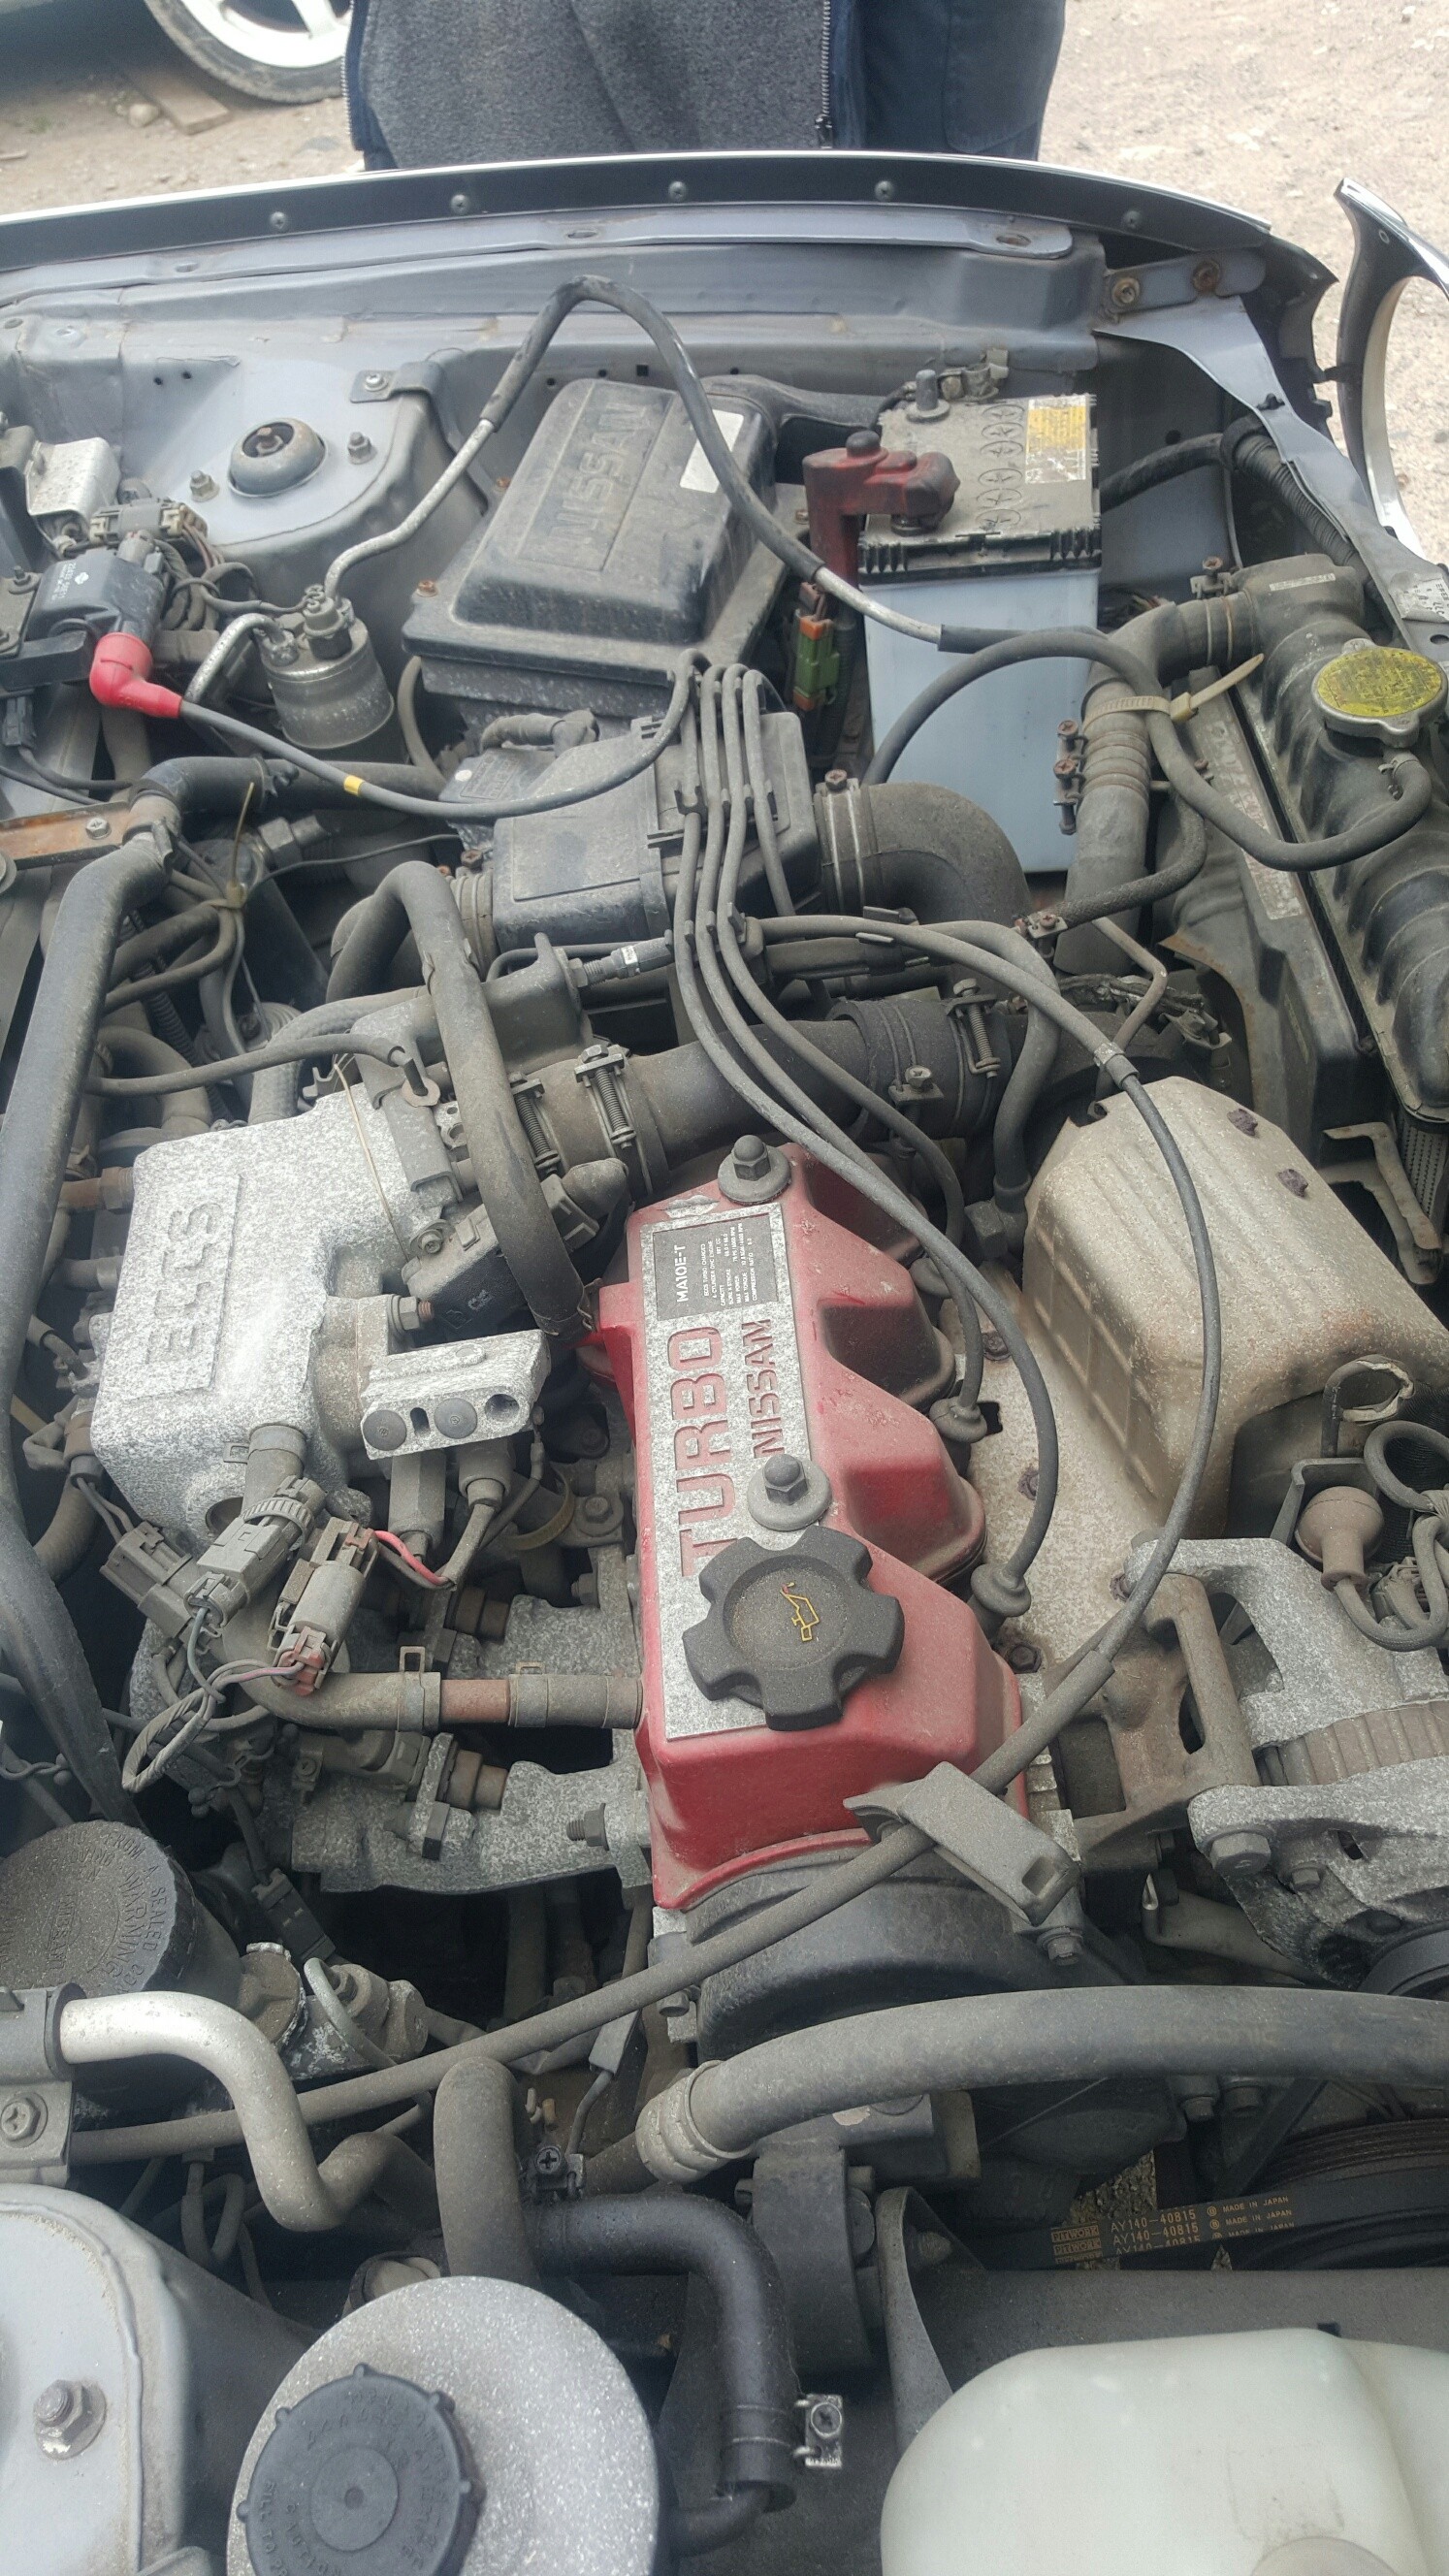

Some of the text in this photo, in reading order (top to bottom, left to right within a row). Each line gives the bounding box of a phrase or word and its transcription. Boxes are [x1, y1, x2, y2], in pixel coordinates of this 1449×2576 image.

[549, 402, 648, 543] NISSAN
[145, 1202, 223, 1364] ECCS
[673, 1244, 690, 1303] MA10E-T
[749, 1268, 757, 1302] COMPRESSION
[741, 1319, 785, 1459] NISSAN
[667, 1326, 738, 1577] TURBO
[102, 1871, 147, 1978] WARNING
[143, 1886, 167, 1951] SEALED
[1052, 2226, 1099, 2242] PITWORK
[1111, 2208, 1197, 2233] AY140-40815
[1223, 2203, 1245, 2213] MADE
[1249, 2201, 1258, 2209] IN
[1264, 2195, 1289, 2206] JAPAN
[1053, 2238, 1102, 2256] PITWORK
[1113, 2222, 1199, 2246] AY140-40815
[1225, 2215, 1248, 2226] MADE
[1252, 2213, 1261, 2222] IN
[1267, 2208, 1292, 2220] JAPAN
